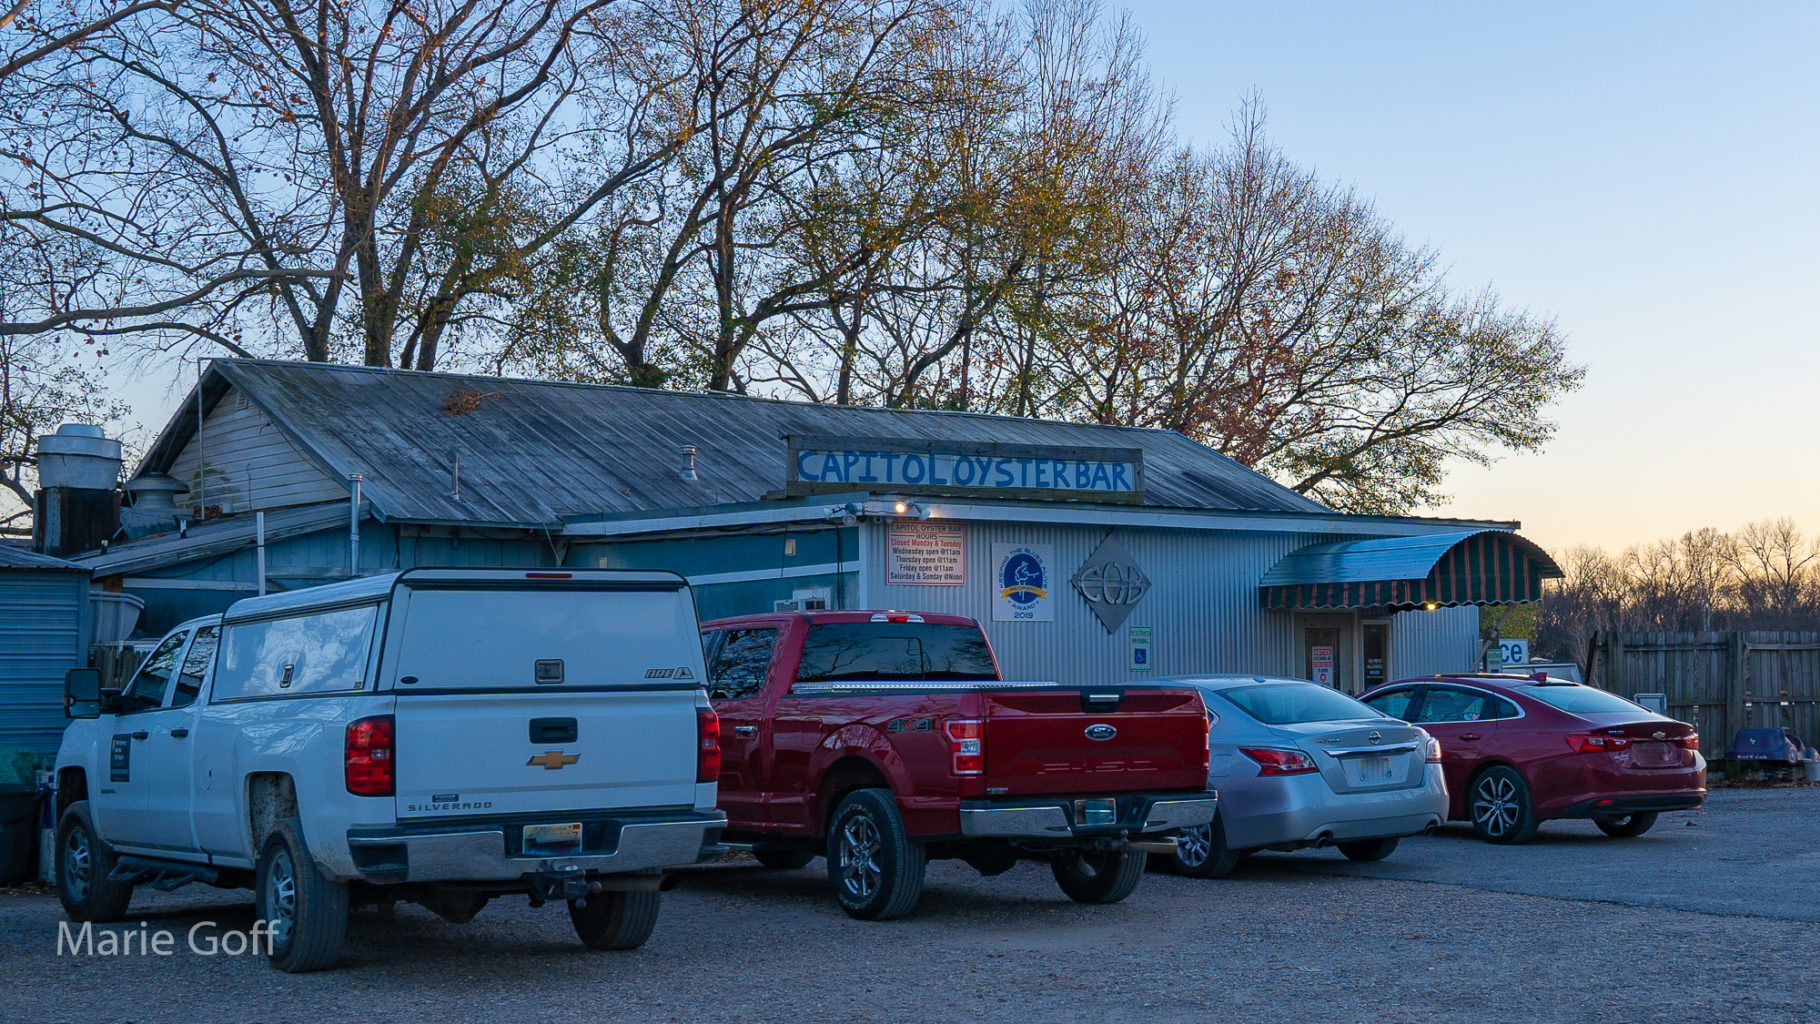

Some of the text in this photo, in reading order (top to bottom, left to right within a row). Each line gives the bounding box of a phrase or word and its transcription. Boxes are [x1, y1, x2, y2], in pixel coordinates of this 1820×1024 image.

[798, 450, 1133, 491] CAPITOL OYSTER BAR
[912, 539, 933, 547] Monday
[941, 540, 962, 549] Tuesday
[893, 547, 924, 556] Wednesday
[1025, 548, 1043, 563] BLUES
[896, 556, 921, 564] Thursday
[922, 557, 936, 565] open
[900, 564, 917, 573] Friday
[890, 572, 915, 581] Saturday
[922, 573, 942, 581] Sunday
[408, 802, 492, 812] SILVERADO
